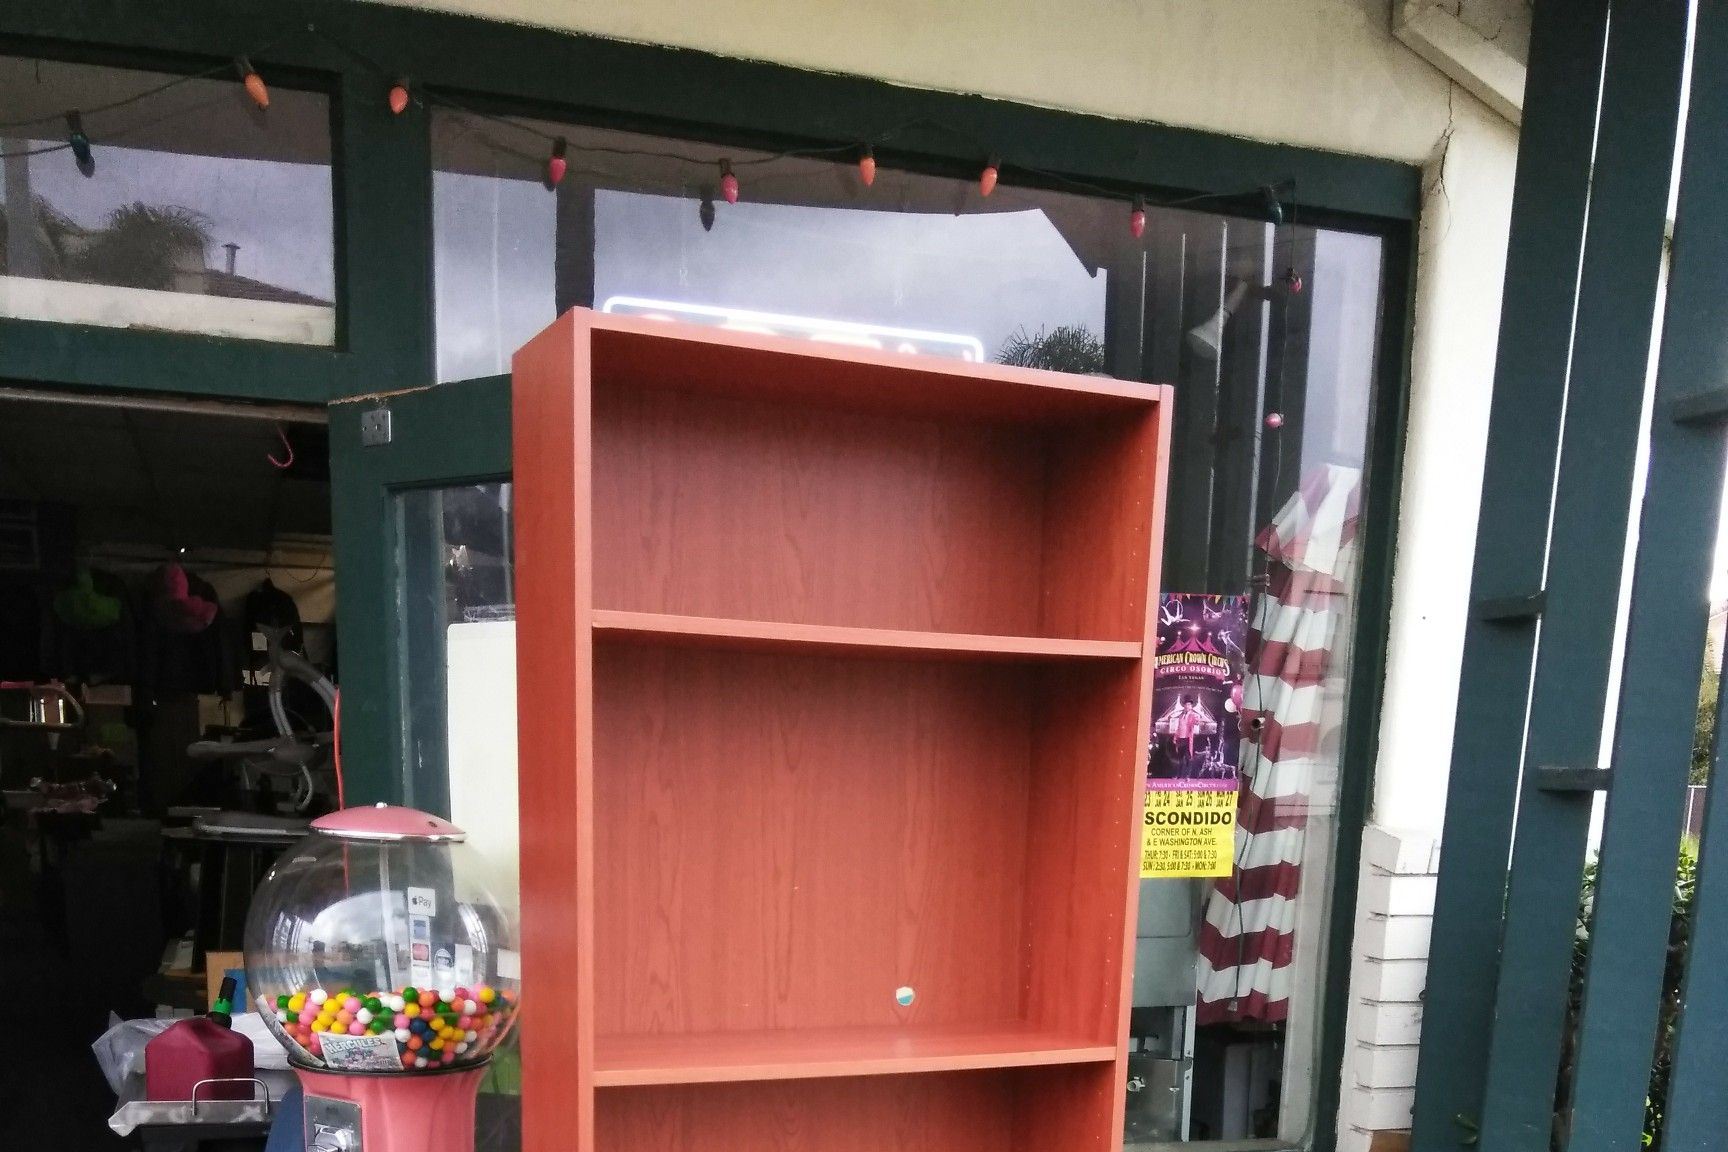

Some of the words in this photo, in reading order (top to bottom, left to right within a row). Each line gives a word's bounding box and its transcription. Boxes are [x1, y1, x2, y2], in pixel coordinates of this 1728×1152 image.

[1160, 665, 1187, 675] CIRCO
[1189, 665, 1221, 675] OSORIO
[1185, 651, 1207, 665] CROWN
[1208, 653, 1231, 676] CIRCUS
[1163, 790, 1170, 806] 24
[1186, 790, 1193, 806] 25
[1205, 790, 1212, 807] 26
[1225, 790, 1233, 807] 27
[1144, 811, 1231, 825] SCONDIDO
[1151, 827, 1180, 836] CORNER
[1181, 828, 1190, 836] OF
[1199, 827, 1212, 836] ASH
[1146, 838, 1151, 846] &
[1159, 837, 1202, 846] WASHINGTON
[418, 896, 432, 908] Pay
[325, 1037, 381, 1055] HERCULES
